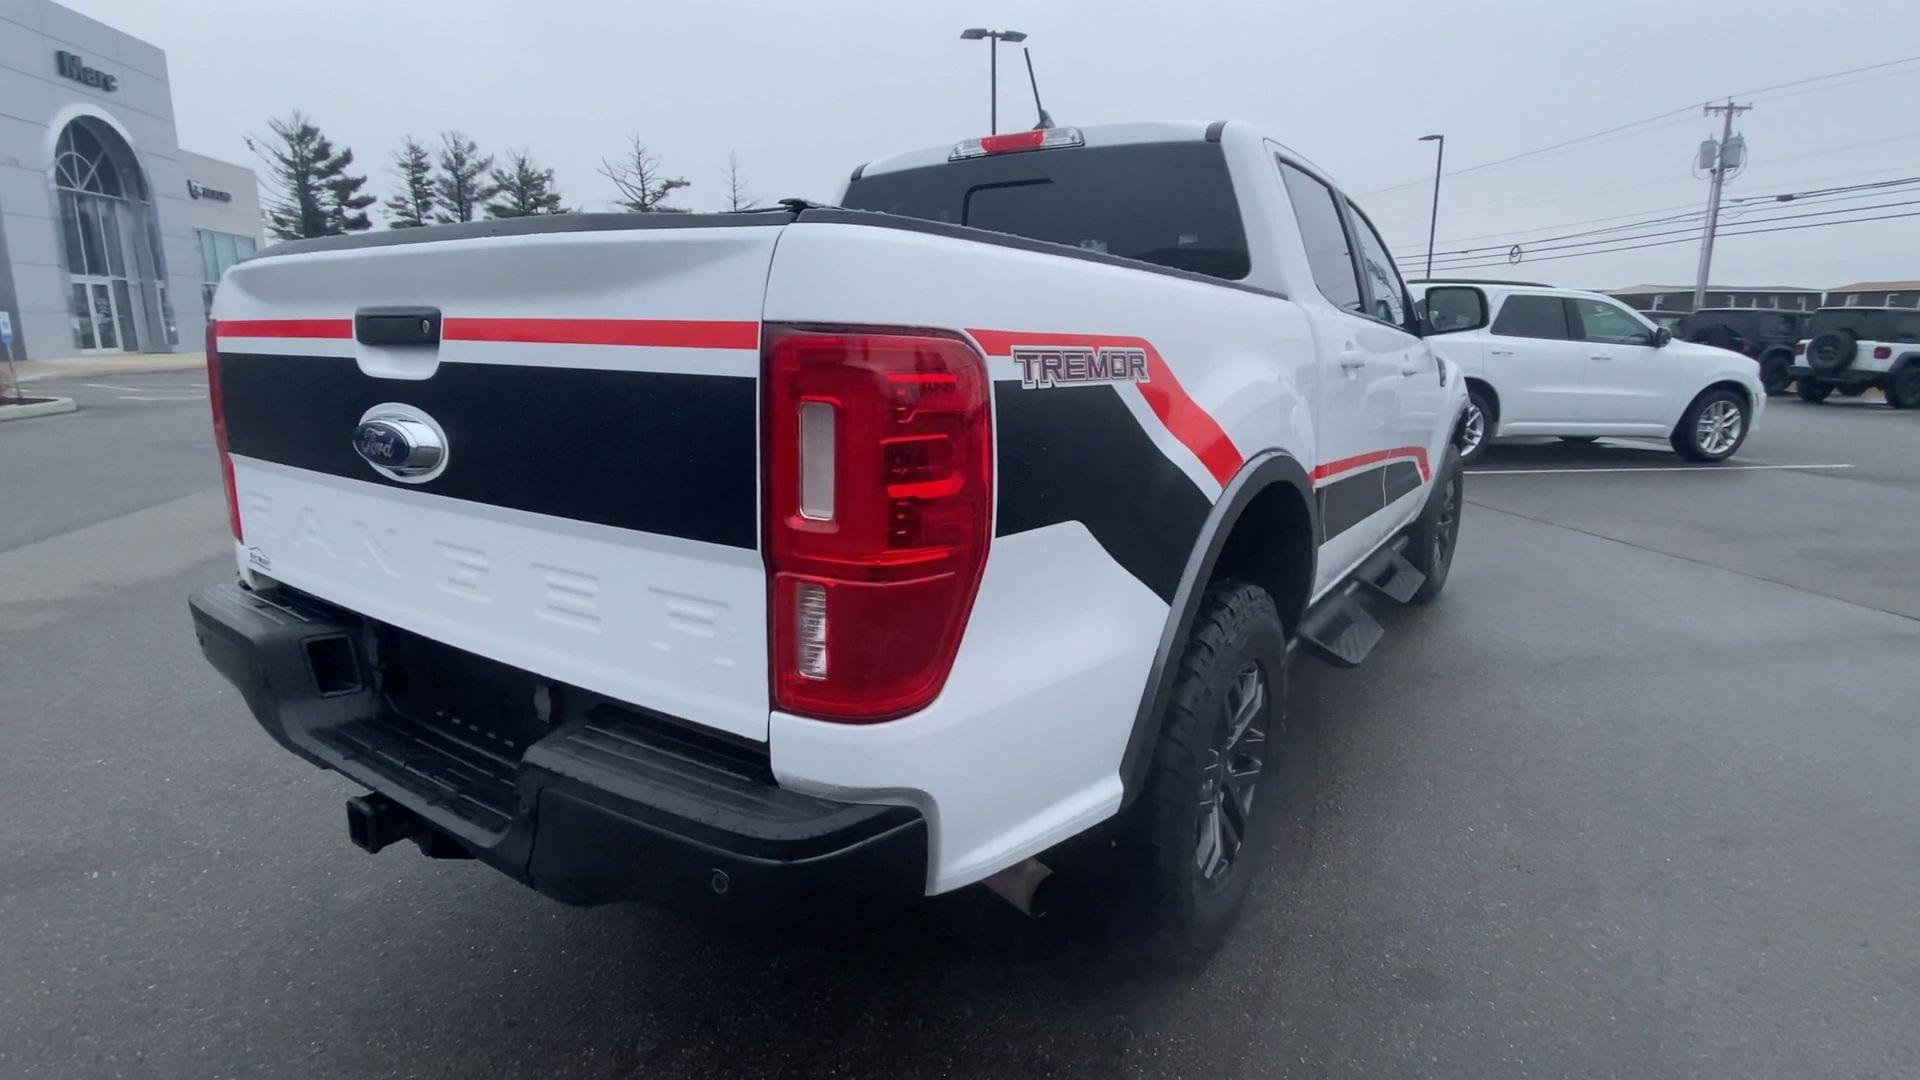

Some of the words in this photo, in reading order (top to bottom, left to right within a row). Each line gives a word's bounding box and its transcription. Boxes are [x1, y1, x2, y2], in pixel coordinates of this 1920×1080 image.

[56, 50, 118, 92] Marc
[1012, 347, 1149, 388] TREMOR
[361, 427, 394, 458] Ford
